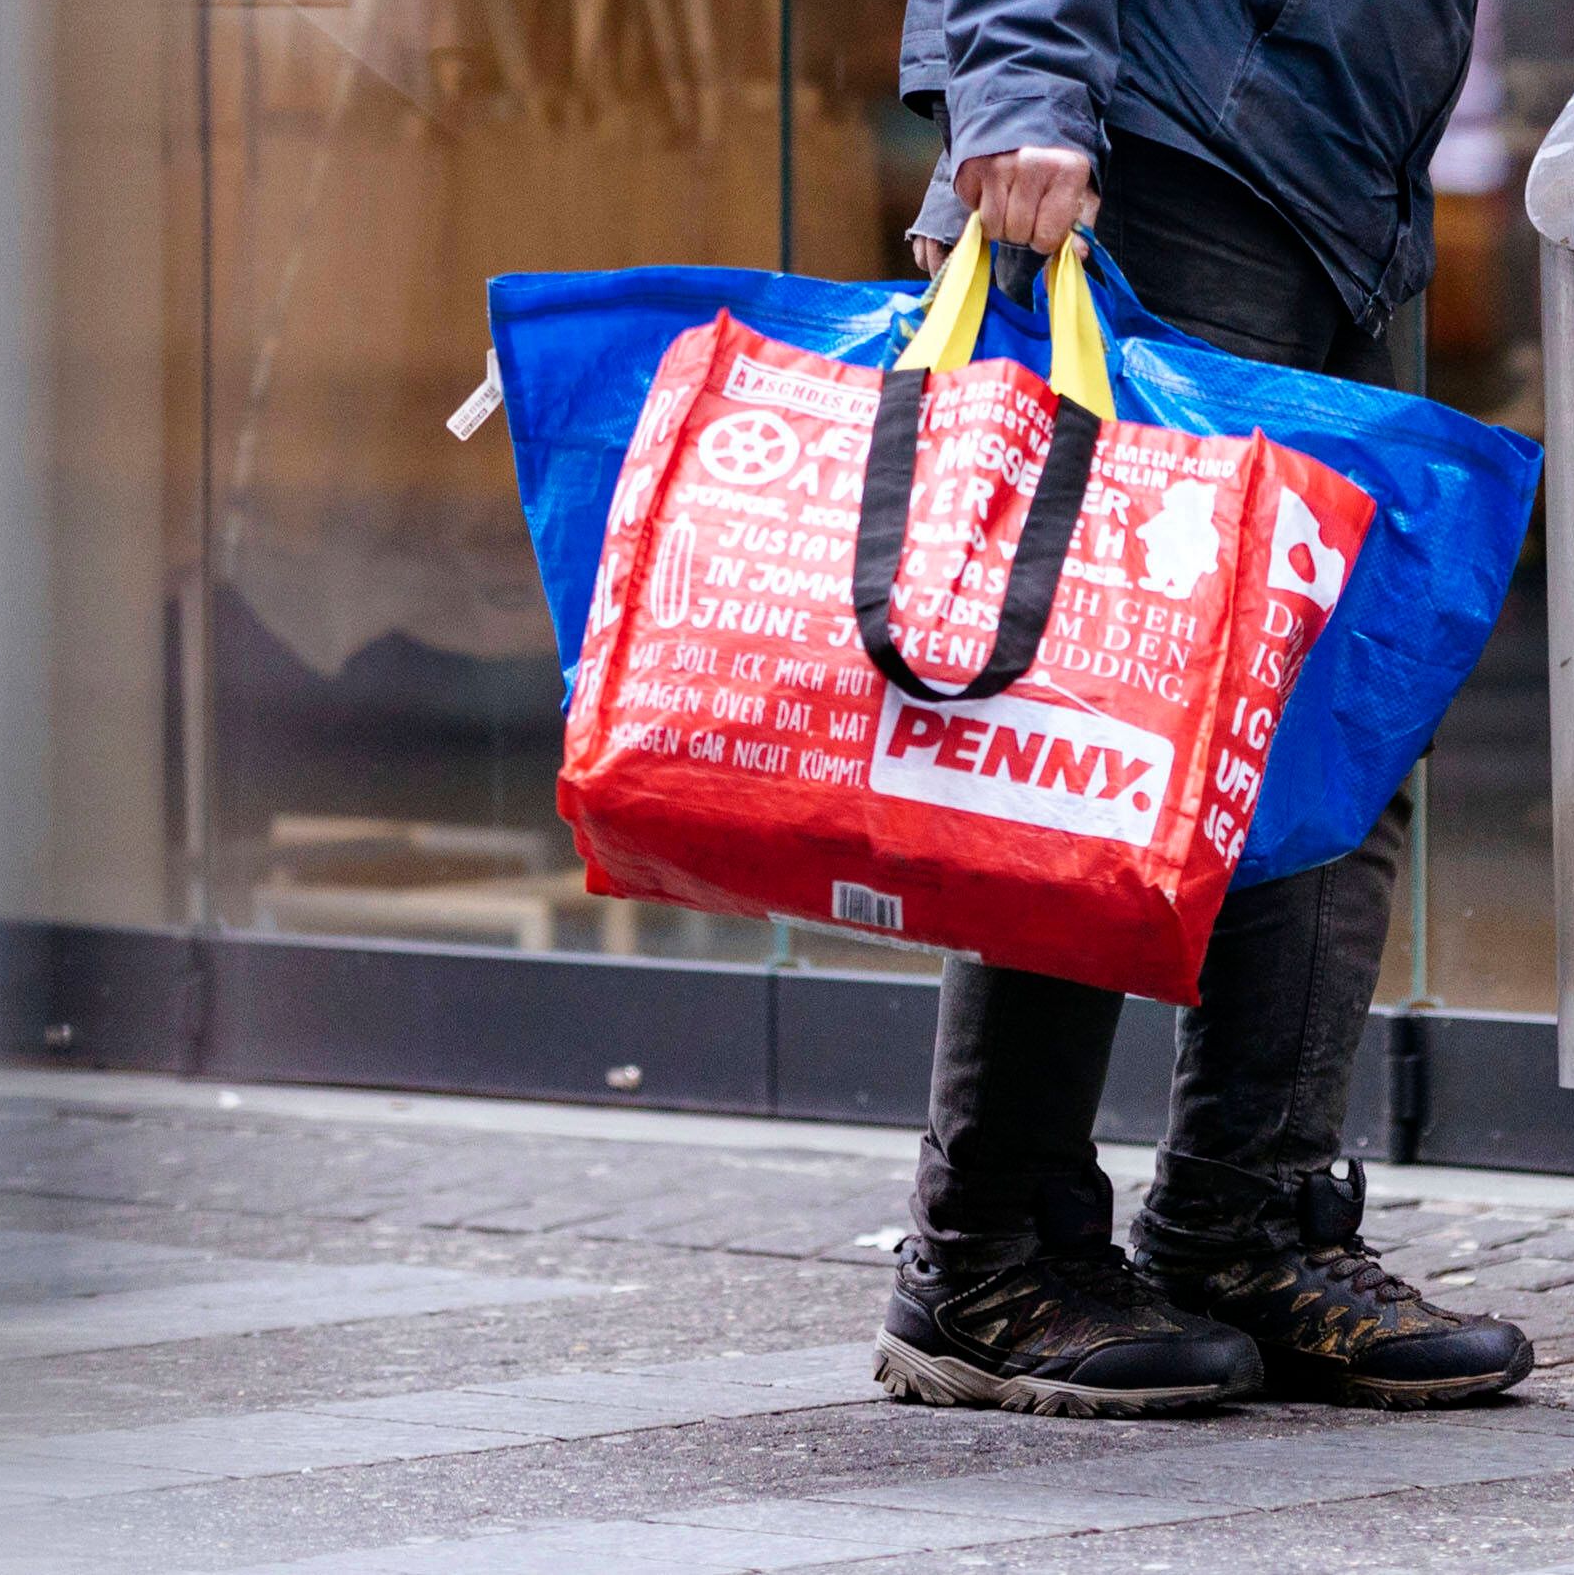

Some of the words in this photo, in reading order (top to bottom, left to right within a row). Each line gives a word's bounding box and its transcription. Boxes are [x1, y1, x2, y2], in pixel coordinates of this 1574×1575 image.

[958, 401, 1029, 437] MUSST
[1114, 443, 1177, 472] MEIN
[1183, 456, 1237, 479] KIND
[1081, 480, 1132, 526] ER
[717, 519, 853, 562] JUSTAV
[703, 554, 746, 589] IN
[690, 596, 811, 643] JRÜNE
[1114, 597, 1197, 642] GEH
[671, 642, 718, 675] SOLL
[730, 651, 767, 683] ICK
[775, 656, 828, 692] MICH
[1104, 623, 1191, 672] DEN
[1036, 636, 1190, 708] UDDING.
[828, 710, 871, 743] WAT
[688, 730, 727, 764] GAR
[732, 738, 792, 773] NICHT
